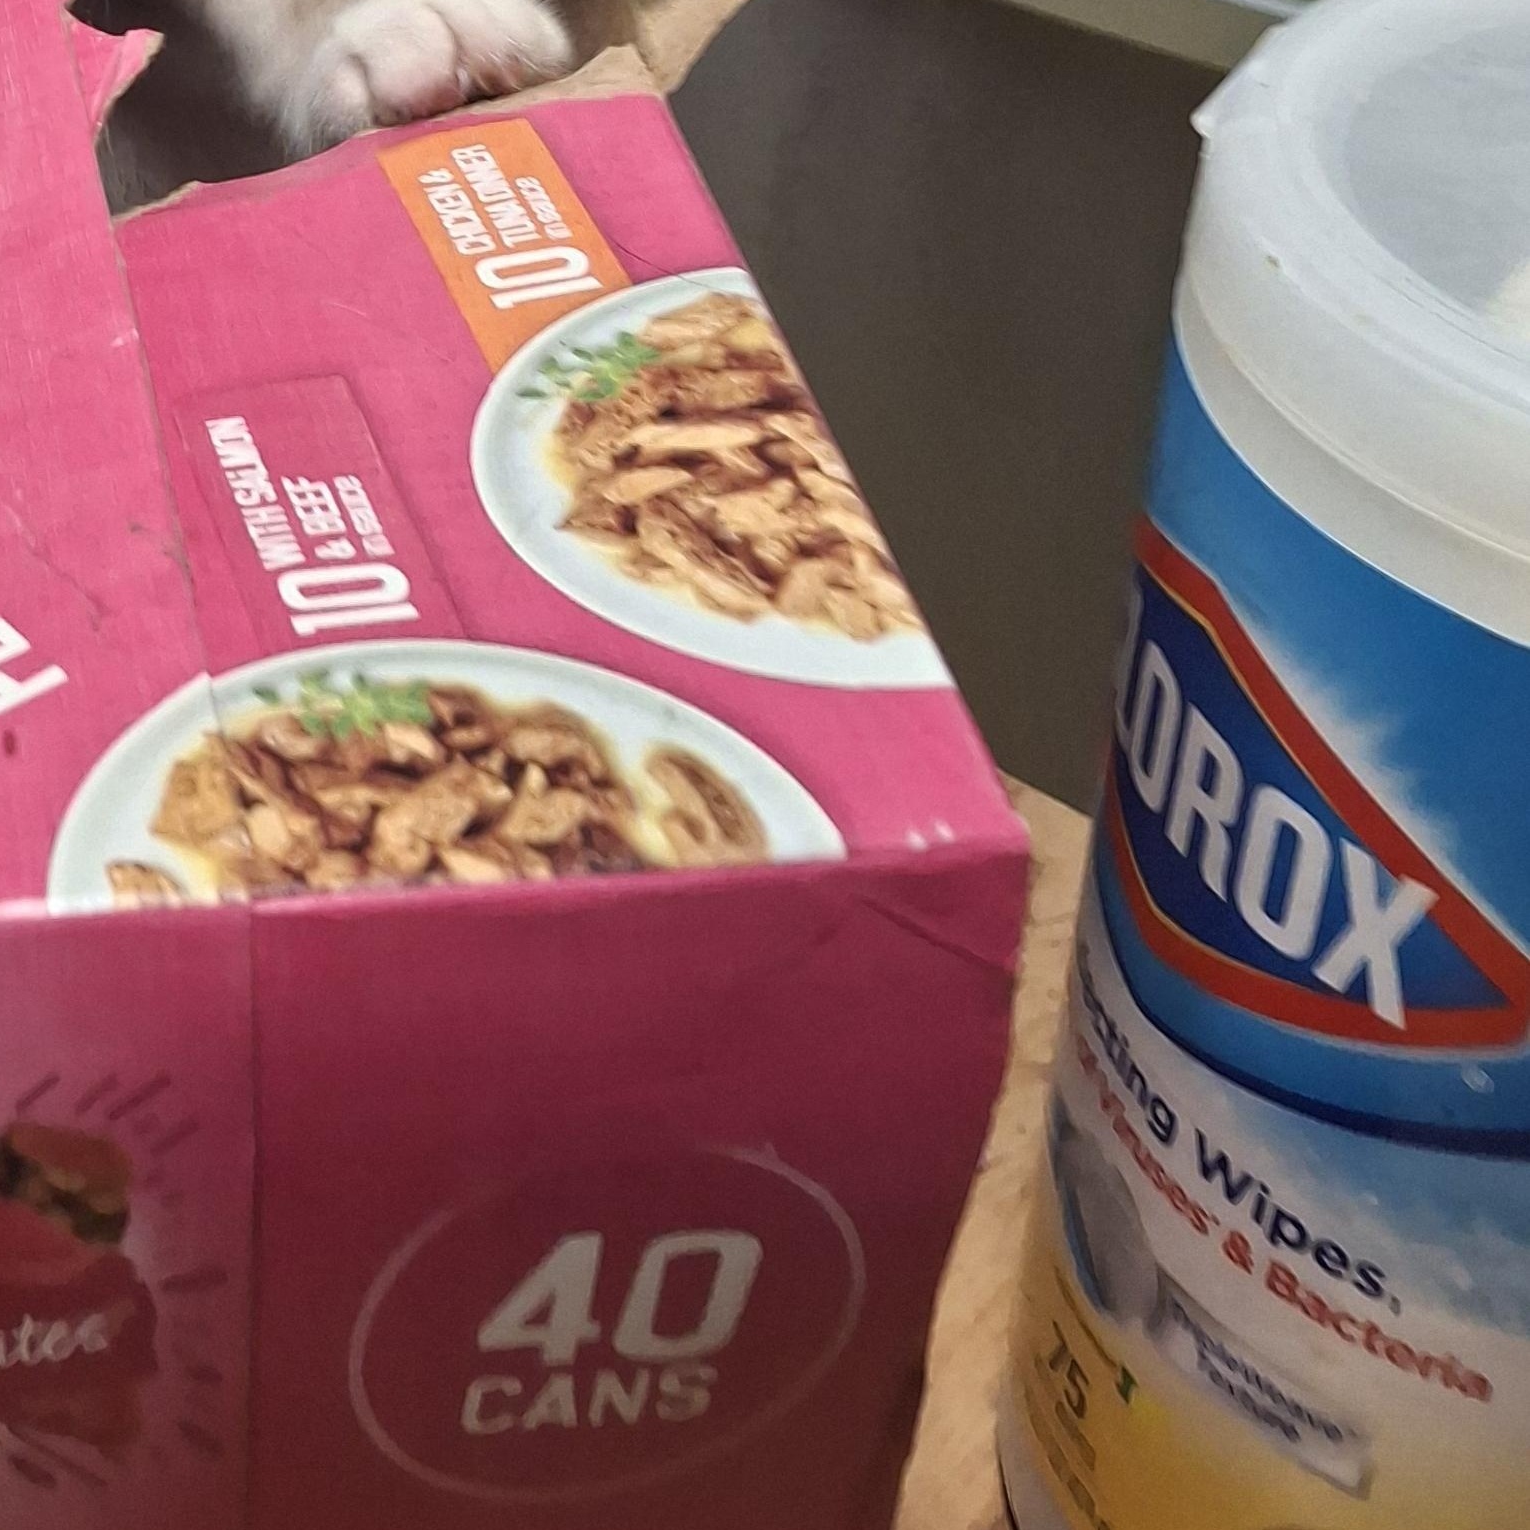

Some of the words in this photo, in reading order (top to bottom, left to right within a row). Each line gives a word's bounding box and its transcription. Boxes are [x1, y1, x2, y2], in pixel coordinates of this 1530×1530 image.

[450, 143, 517, 205] DINNER
[423, 182, 497, 256] CHICKEN
[483, 200, 543, 249] TUNA
[474, 245, 605, 310] 10
[204, 415, 279, 508] SALMON
[239, 505, 307, 572] WITH
[280, 475, 348, 537] BEEF
[277, 562, 420, 637] 10
[1115, 575, 1442, 1032] LOROX
[476, 1227, 765, 1368] 40
[1263, 1260, 1494, 1403] Bacteria
[459, 1362, 719, 1436] CANS
